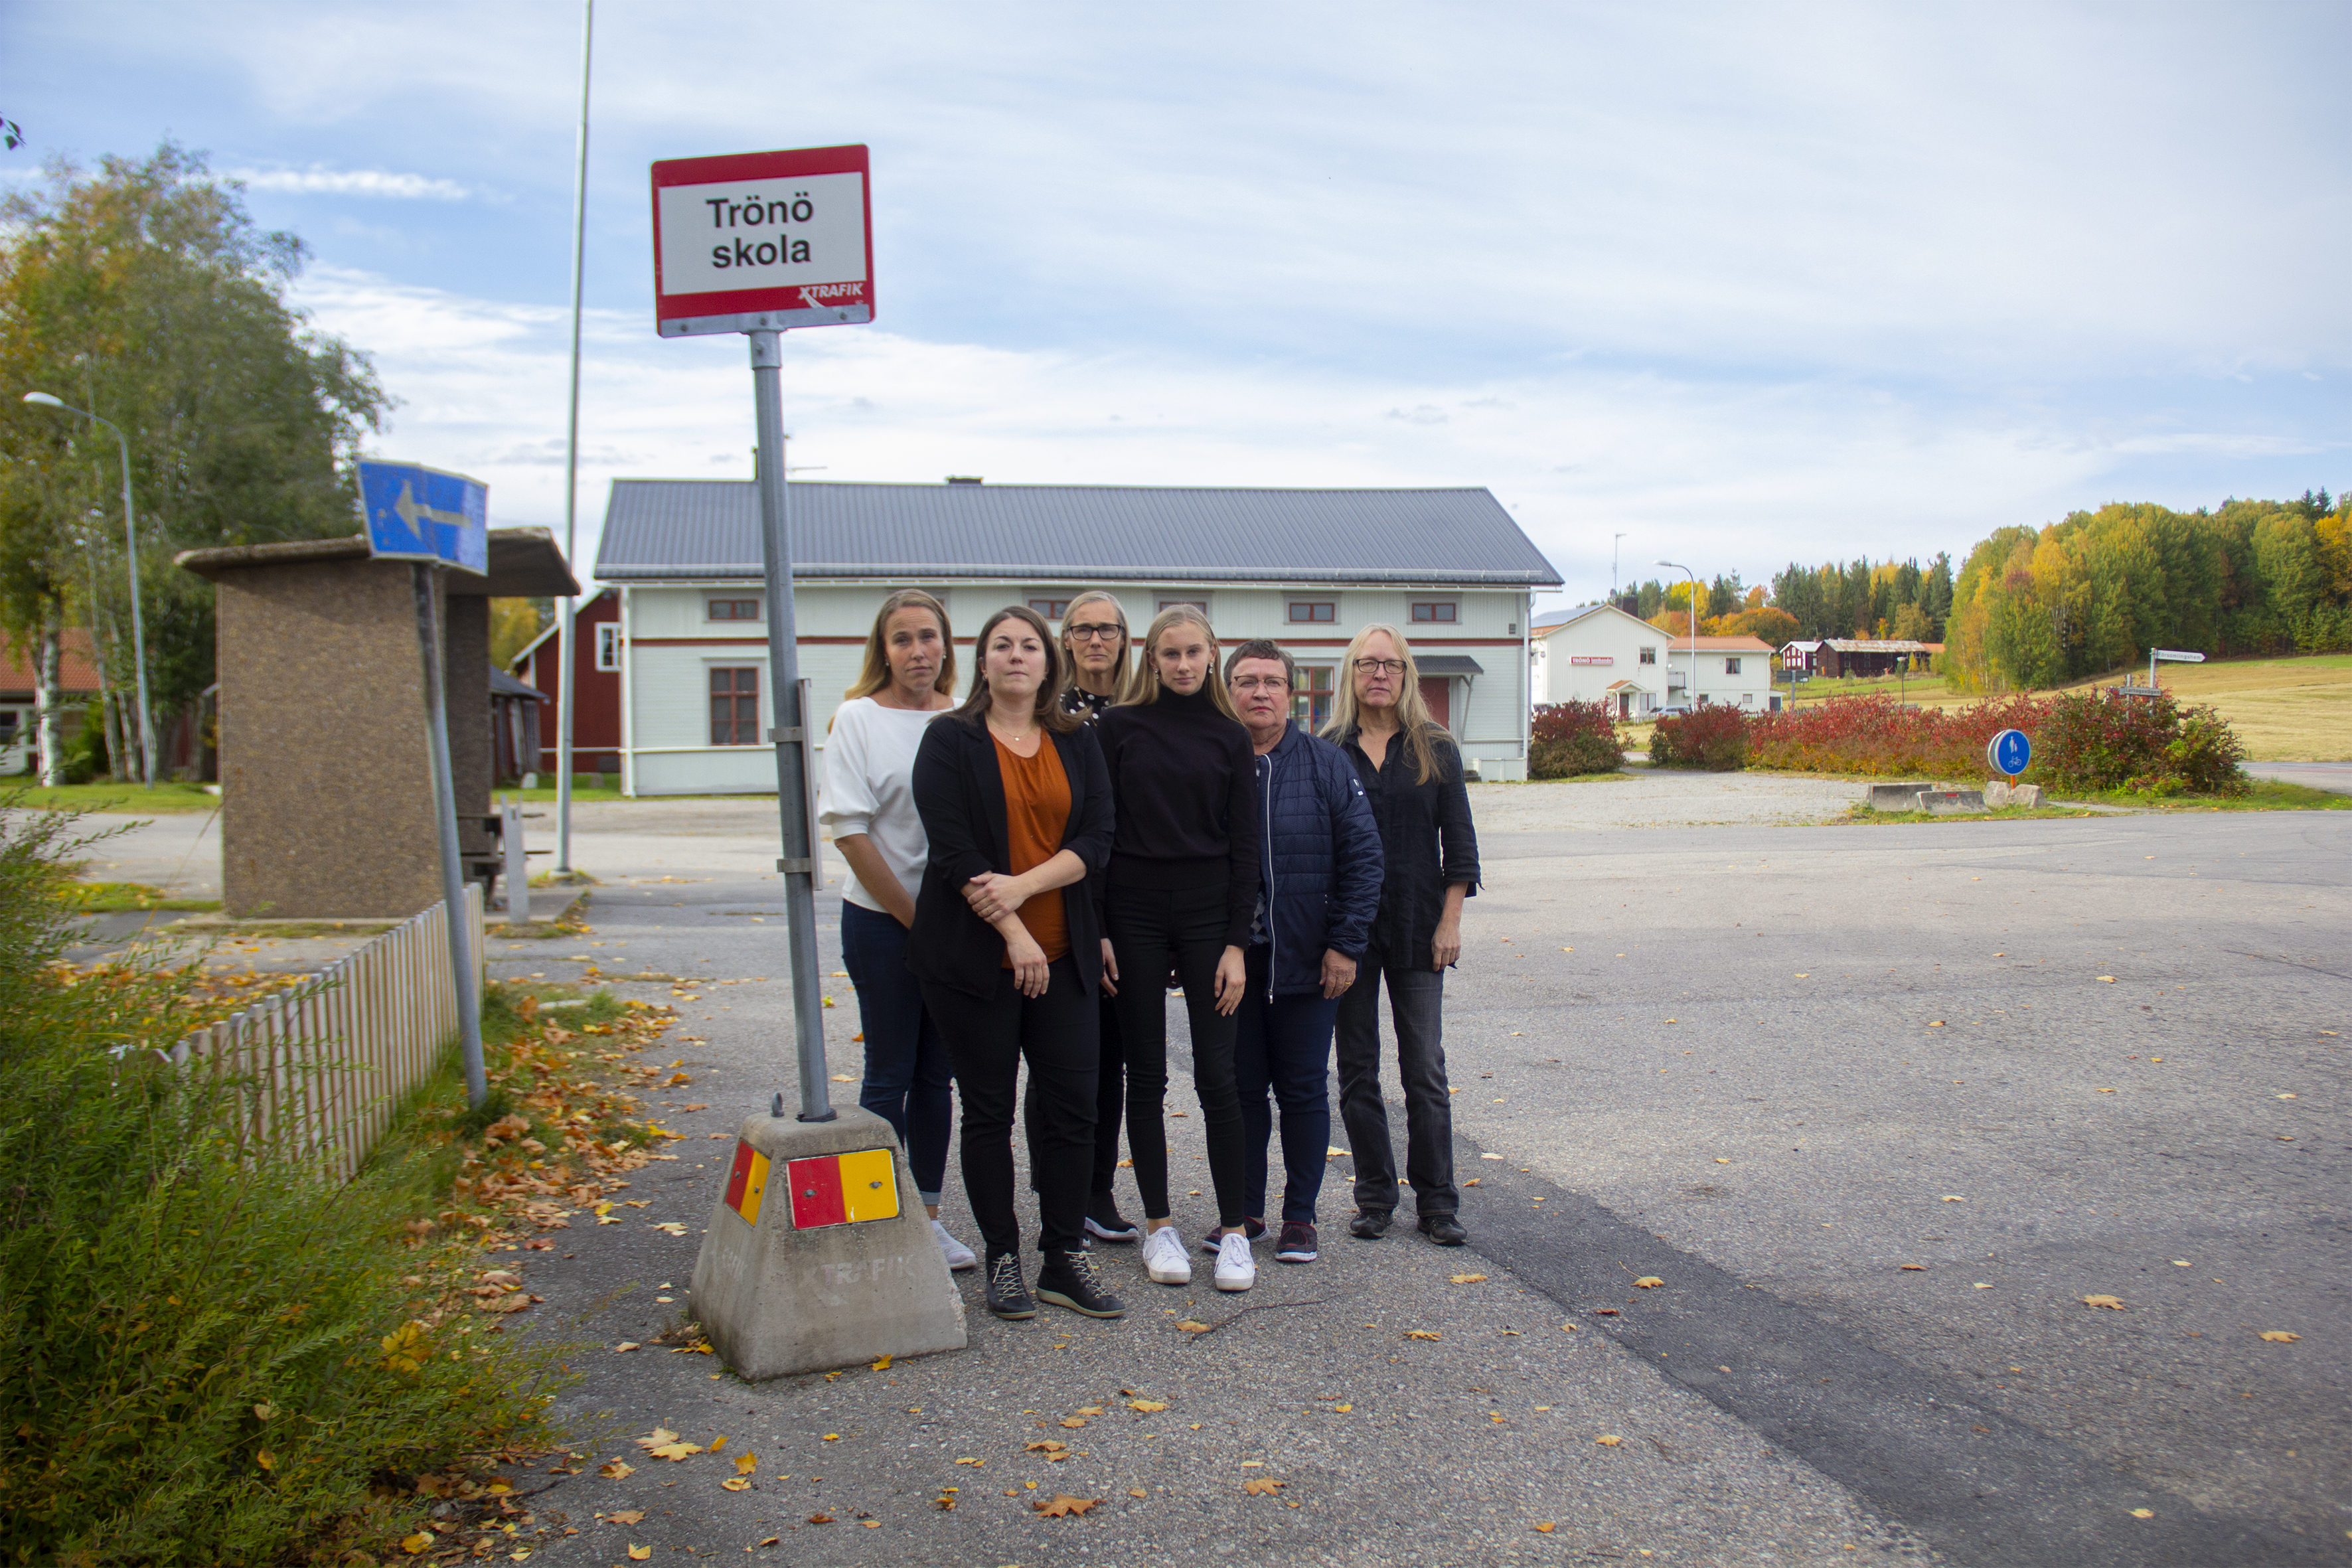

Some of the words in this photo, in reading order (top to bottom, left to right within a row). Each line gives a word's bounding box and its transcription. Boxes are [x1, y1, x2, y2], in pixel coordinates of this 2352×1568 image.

[705, 191, 814, 228] Trönö
[712, 234, 812, 269] skola
[798, 283, 863, 299] XTRAFIK
[2158, 651, 2201, 660] Församlingshem
